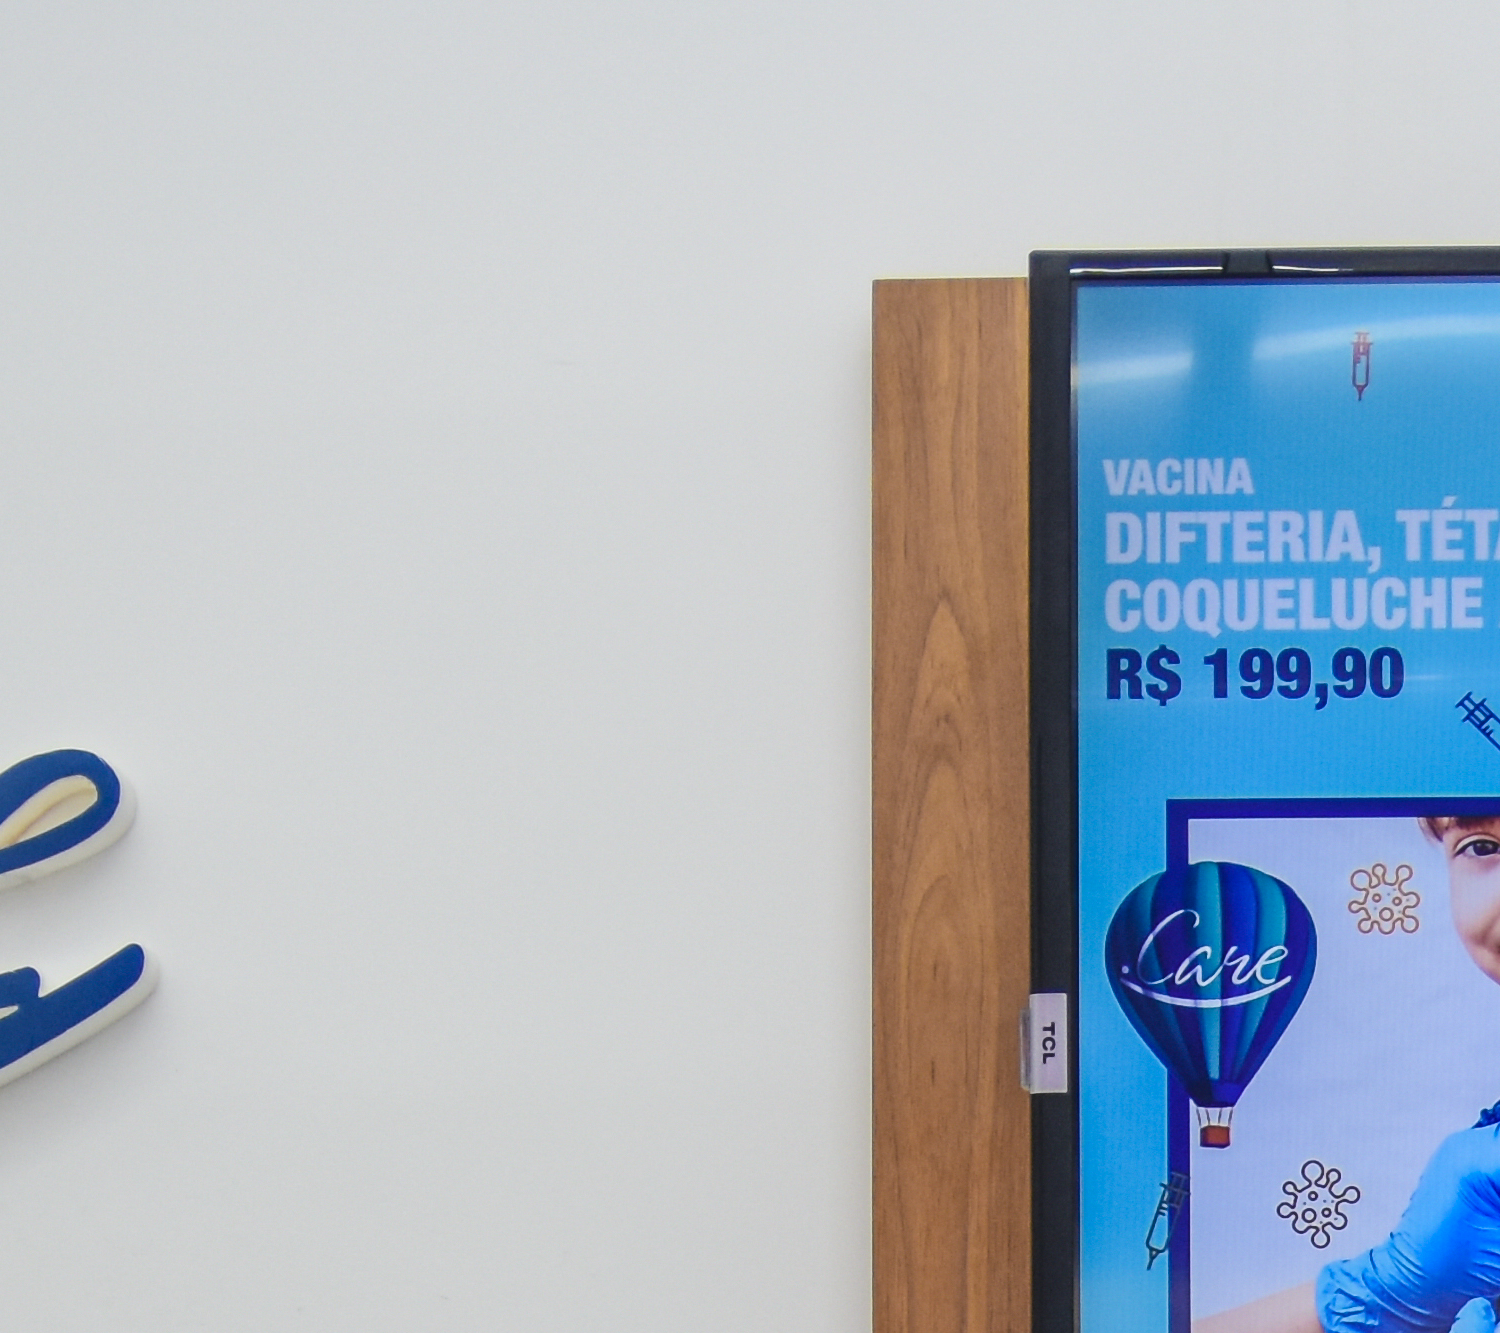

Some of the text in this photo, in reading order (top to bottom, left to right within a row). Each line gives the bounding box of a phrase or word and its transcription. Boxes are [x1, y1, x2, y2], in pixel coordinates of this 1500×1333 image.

[1103, 458, 1255, 496] VACINA
[1105, 512, 1381, 572] DIFTERIA,
[1104, 577, 1484, 634] COQUELUCHE
[1105, 645, 1405, 710] R$ 199,90
[1042, 1021, 1056, 1064] TCL
